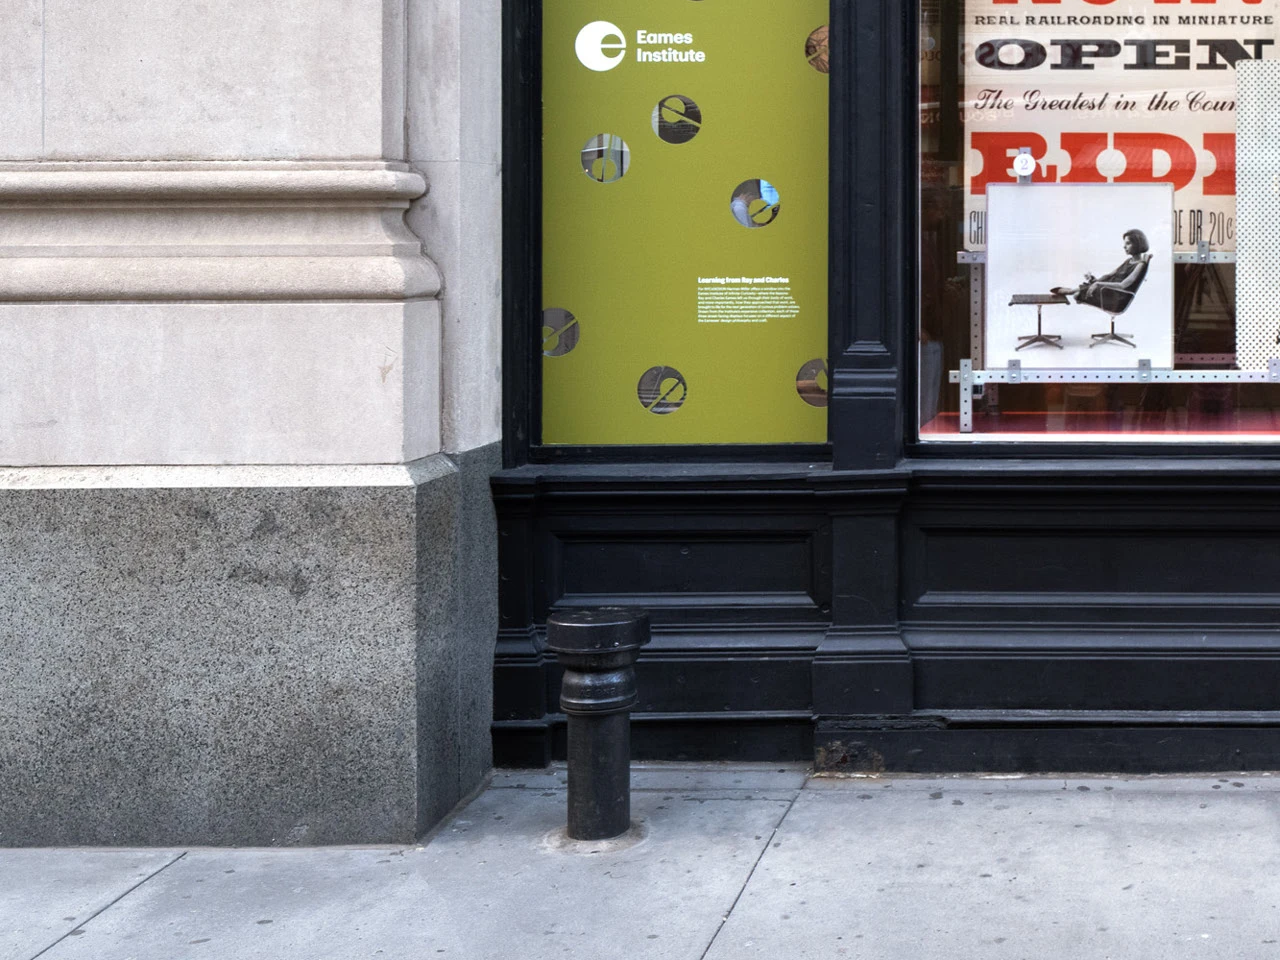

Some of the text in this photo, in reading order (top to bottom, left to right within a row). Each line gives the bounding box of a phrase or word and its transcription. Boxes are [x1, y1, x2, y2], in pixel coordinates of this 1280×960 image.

[974, 15, 1274, 26] REAL RAILROADING IN MINIATURE
[636, 30, 693, 44] Eames
[636, 47, 706, 63] Institute
[974, 38, 1275, 71] OPEN
[974, 88, 1015, 110] The
[1022, 89, 1110, 111] Greatest
[1114, 93, 1137, 111] in
[1147, 90, 1181, 111] the
[1020, 158, 1029, 171] 2
